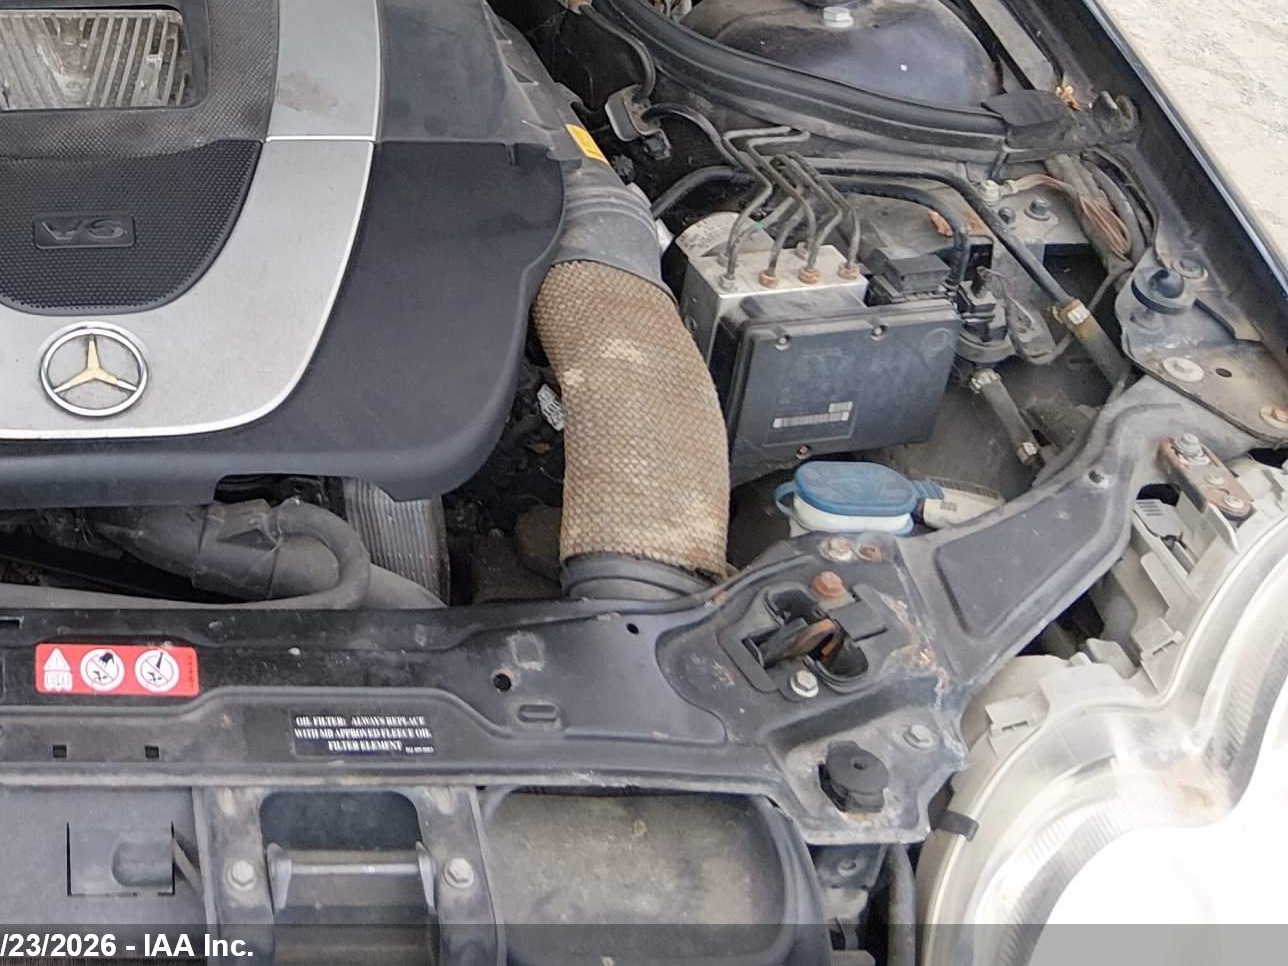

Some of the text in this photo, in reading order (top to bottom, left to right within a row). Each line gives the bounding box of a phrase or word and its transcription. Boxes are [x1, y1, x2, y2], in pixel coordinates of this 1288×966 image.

[295, 716, 312, 727] OIL
[351, 716, 385, 727] ALWAYS
[385, 716, 425, 726] REPLACE
[294, 728, 319, 739] WITH
[335, 728, 381, 739] APPROVED
[415, 728, 432, 739] OIL
[328, 740, 359, 751] FILTER
[360, 740, 402, 751] ELEMENT
